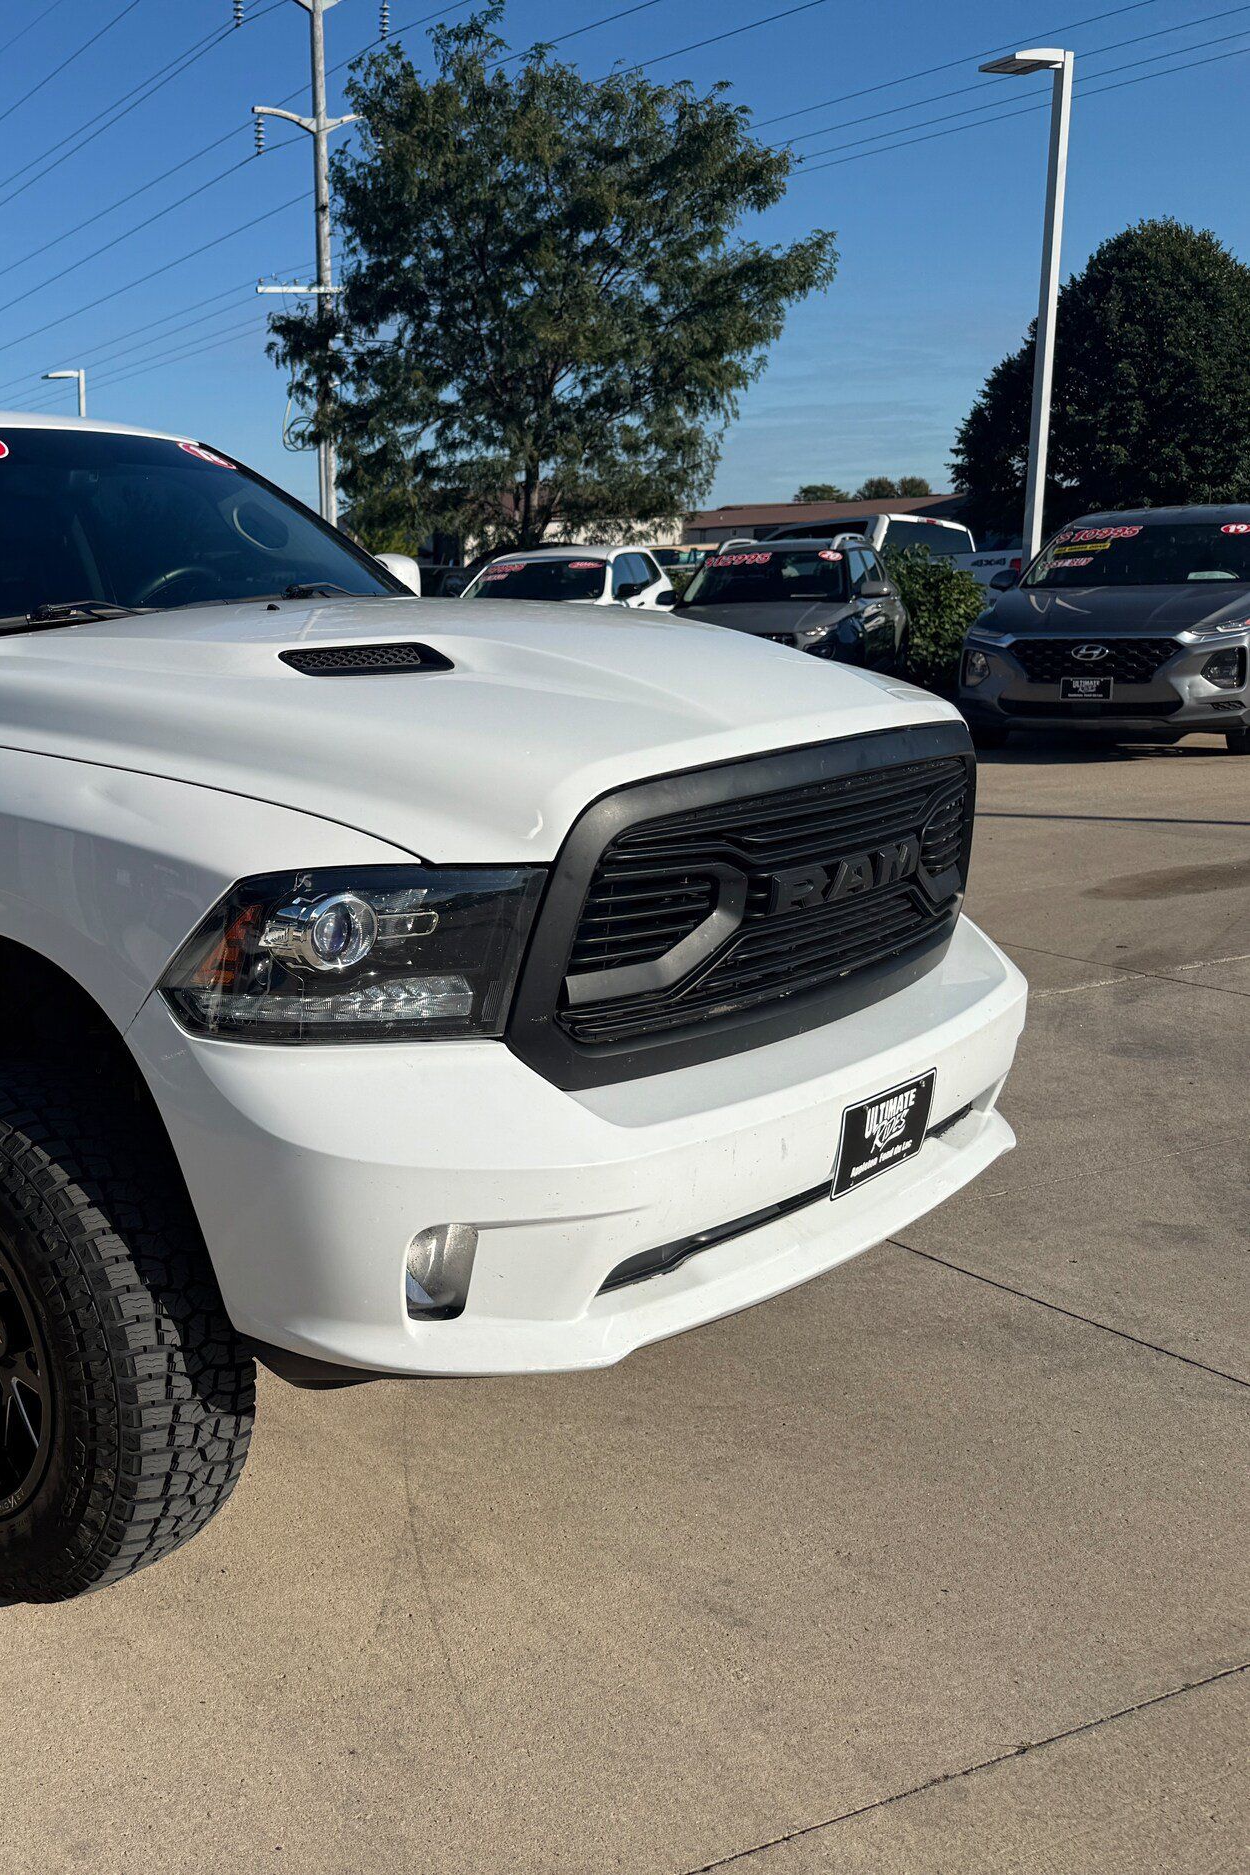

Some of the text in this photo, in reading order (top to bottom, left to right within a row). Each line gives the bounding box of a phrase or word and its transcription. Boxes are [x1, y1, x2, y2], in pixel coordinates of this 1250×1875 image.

[1228, 524, 1246, 533] 19
[769, 832, 919, 914] RAM
[865, 1088, 917, 1139] ULTIMATE
